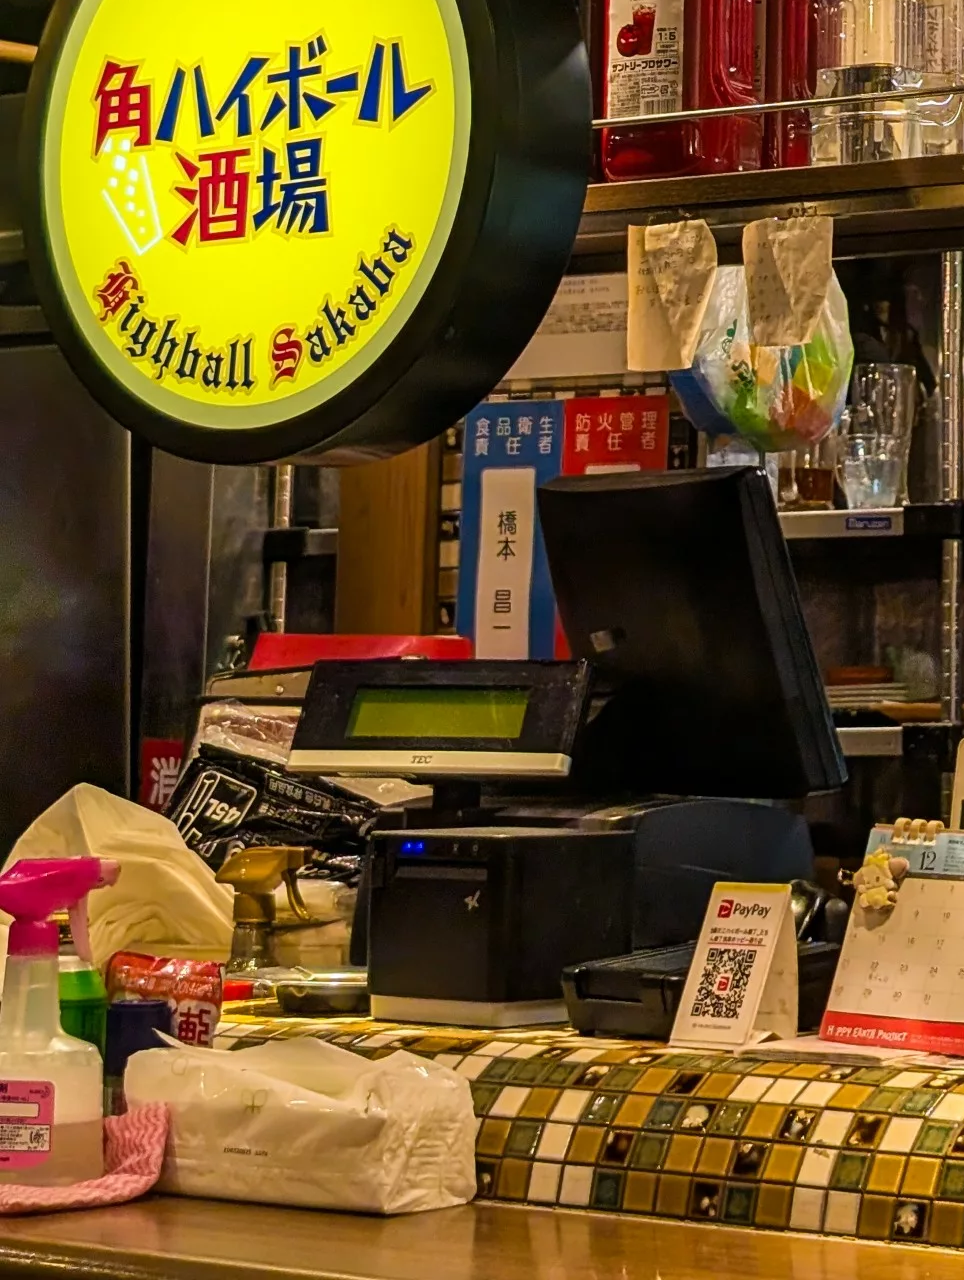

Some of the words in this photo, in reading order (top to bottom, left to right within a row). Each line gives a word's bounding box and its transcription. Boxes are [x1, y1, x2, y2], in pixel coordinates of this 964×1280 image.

[92, 33, 434, 157] 角ハイボール
[172, 137, 328, 246] 酒場
[98, 261, 256, 393] Highball
[272, 227, 416, 385] Sakaba
[475, 416, 554, 438] 食品衛生
[574, 411, 658, 433] 防火管理
[474, 434, 553, 456] 責任者
[574, 431, 657, 453] 責任者
[496, 508, 519, 562] 橋本
[410, 754, 434, 765] TEC
[203, 798, 241, 824] 45L
[919, 851, 937, 871] 12
[733, 903, 772, 919] PayPay
[827, 1025, 852, 1038] HPPY
[852, 1027, 876, 1040] EARTH
